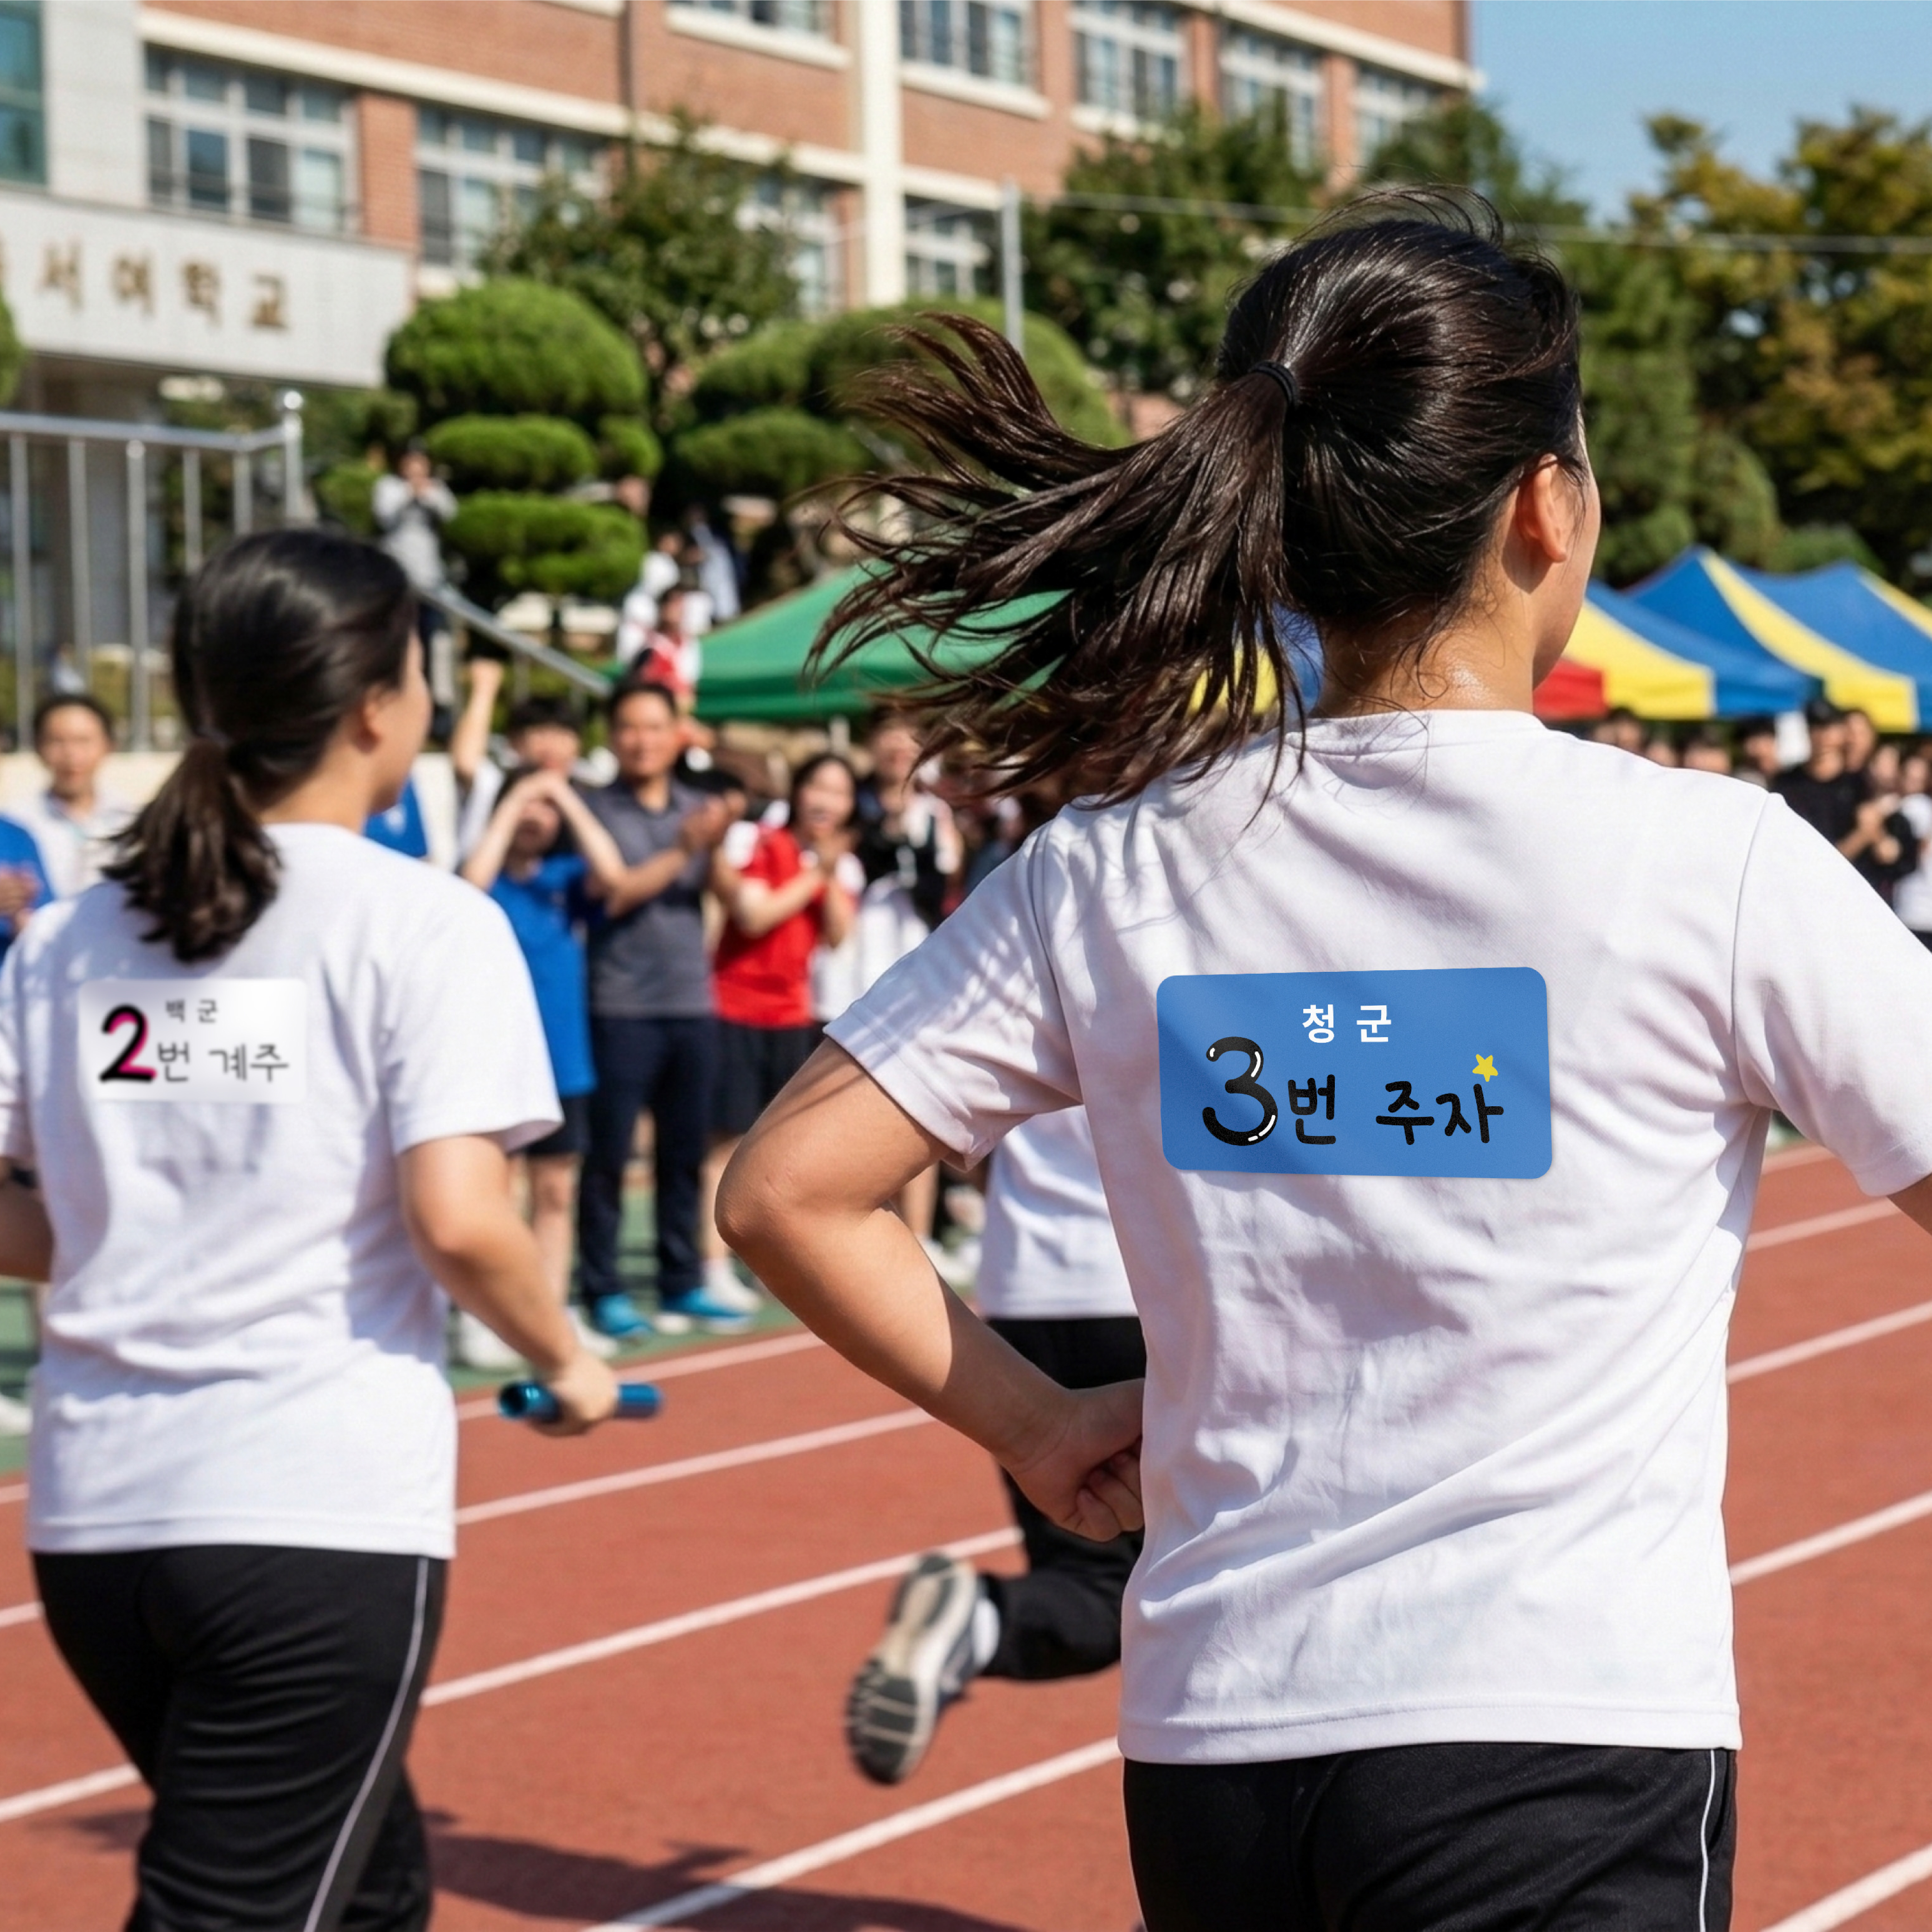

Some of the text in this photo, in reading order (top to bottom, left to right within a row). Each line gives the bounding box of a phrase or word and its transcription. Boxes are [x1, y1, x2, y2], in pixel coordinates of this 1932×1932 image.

[208, 1043, 289, 1082] 계주
[1201, 1036, 1505, 1147] 3번 주자
